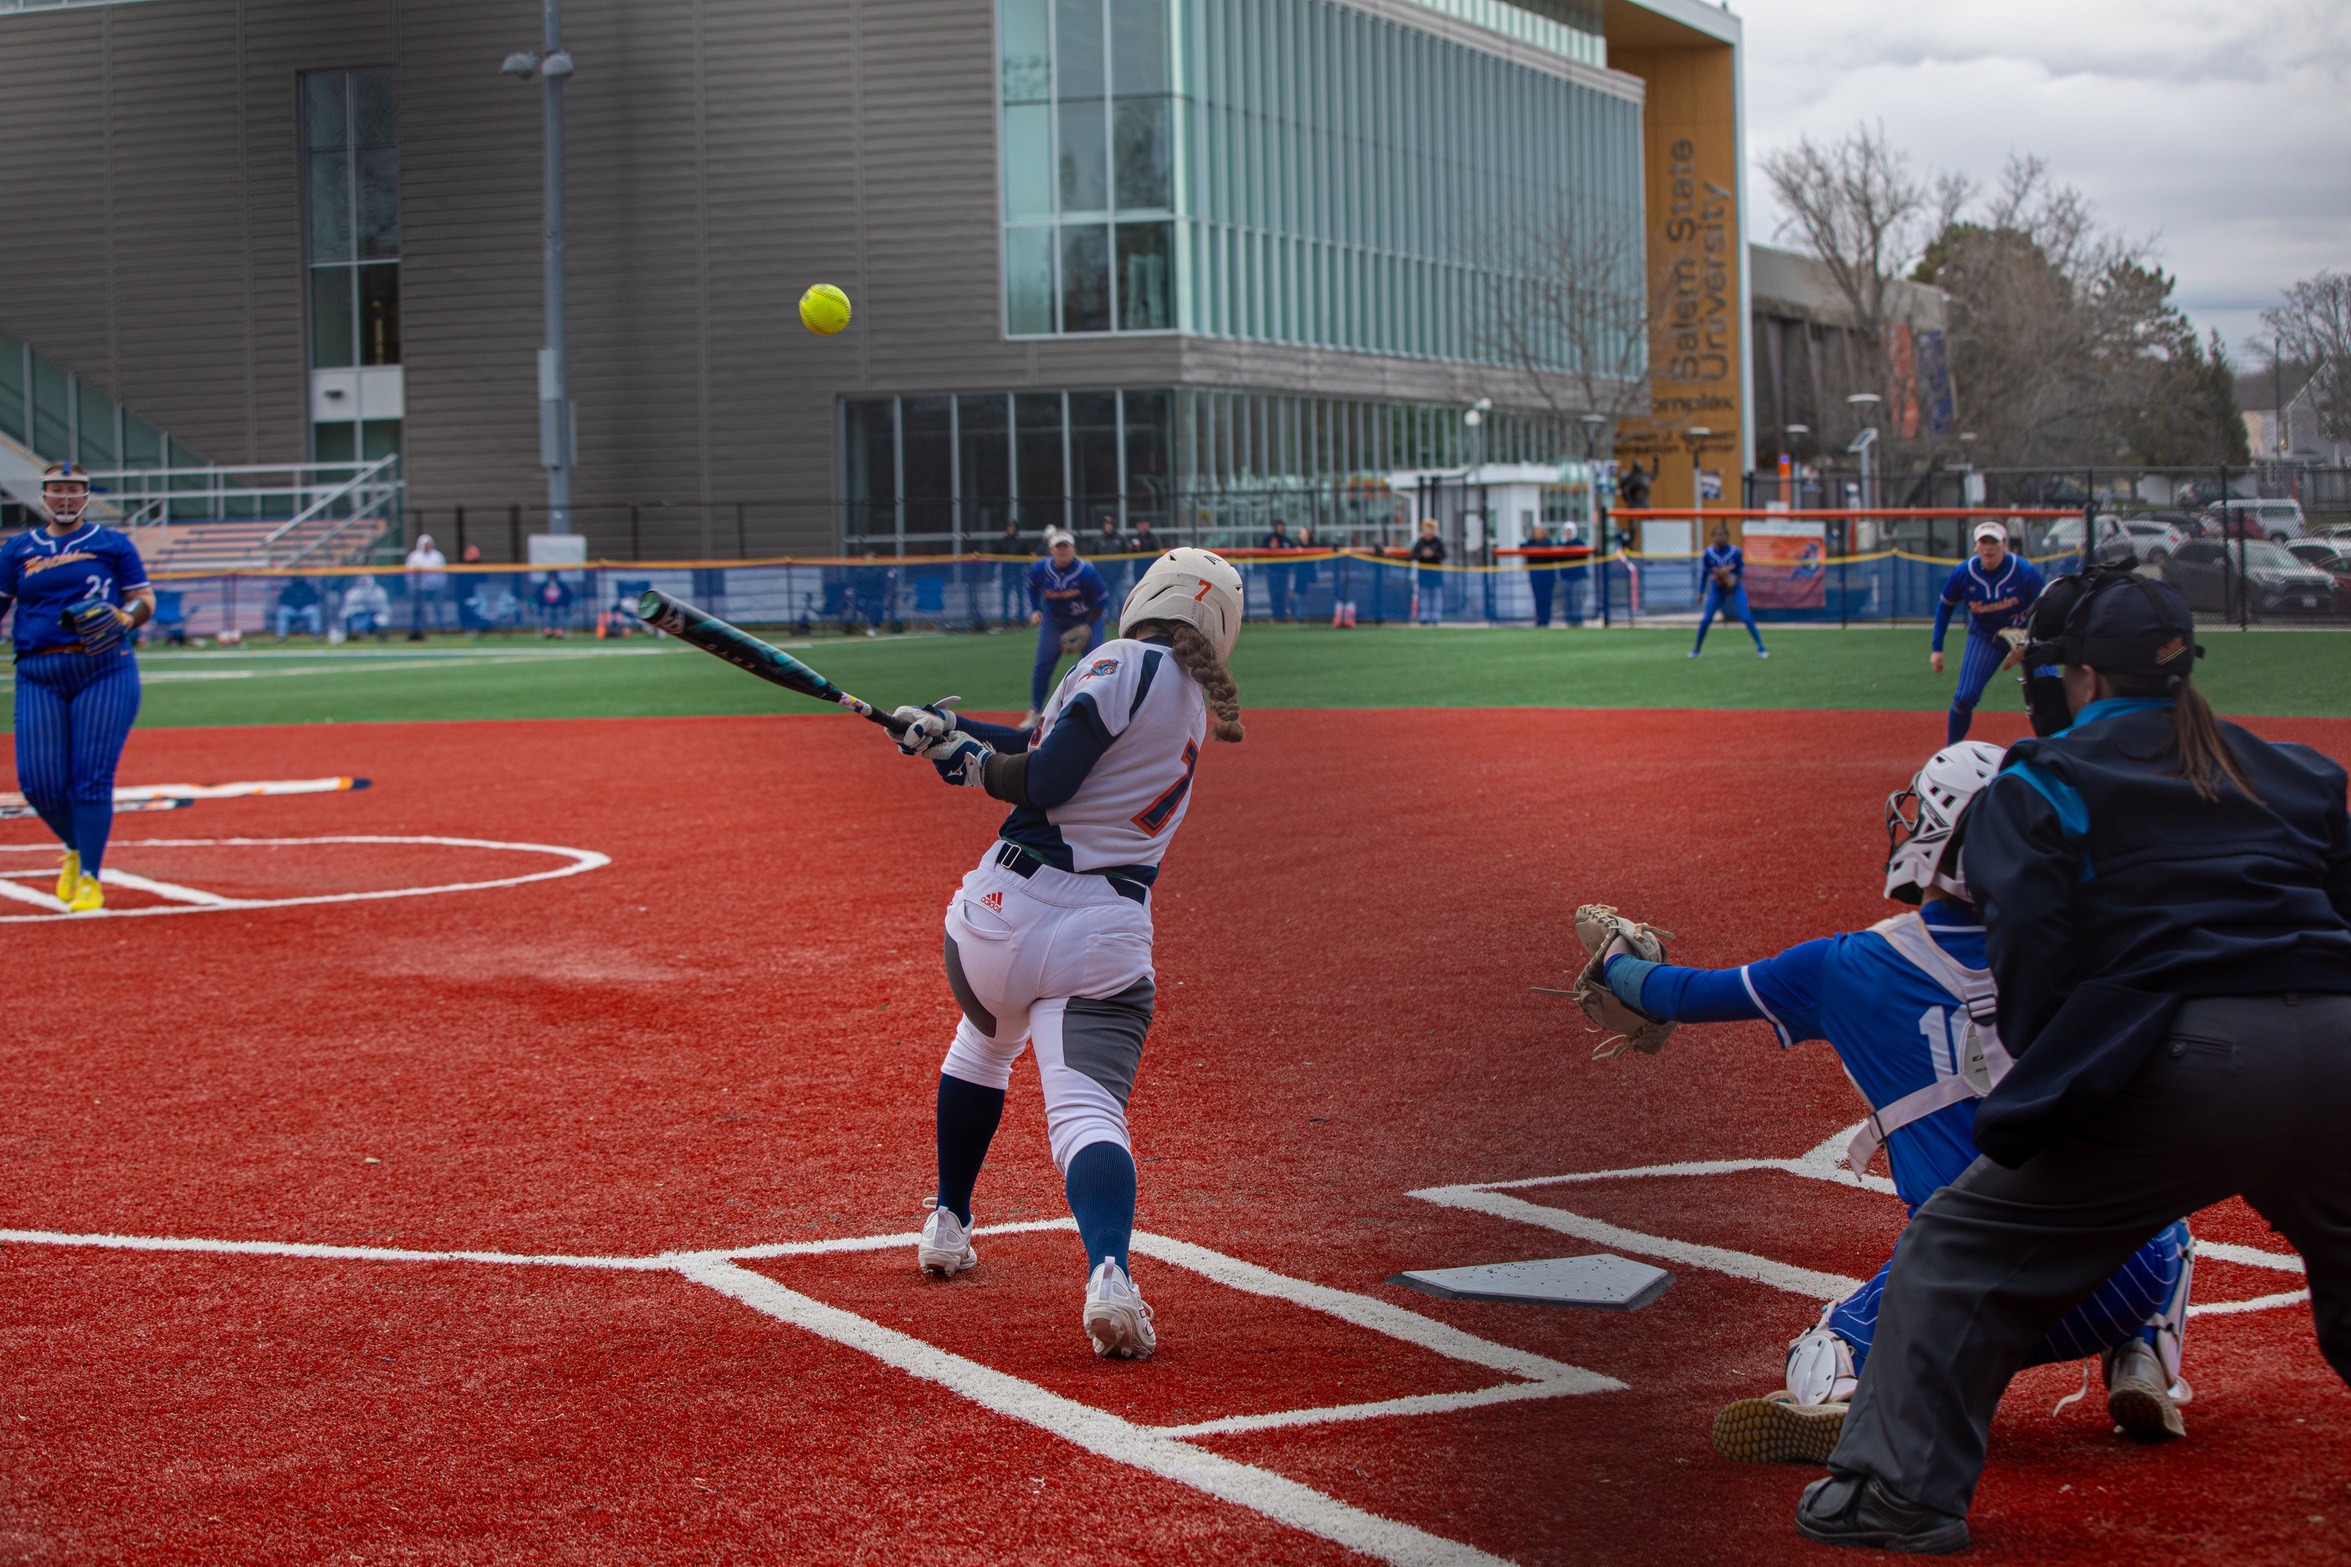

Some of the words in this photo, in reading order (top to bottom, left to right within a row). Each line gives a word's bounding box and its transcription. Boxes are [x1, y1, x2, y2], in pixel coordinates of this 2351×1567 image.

[1667, 137, 1696, 243] State
[1701, 180, 1732, 382] University
[1669, 257, 1700, 382] Salem
[1652, 394, 1735, 416] omplex
[1194, 579, 1212, 602] 7
[980, 896, 1003, 914] adidas
